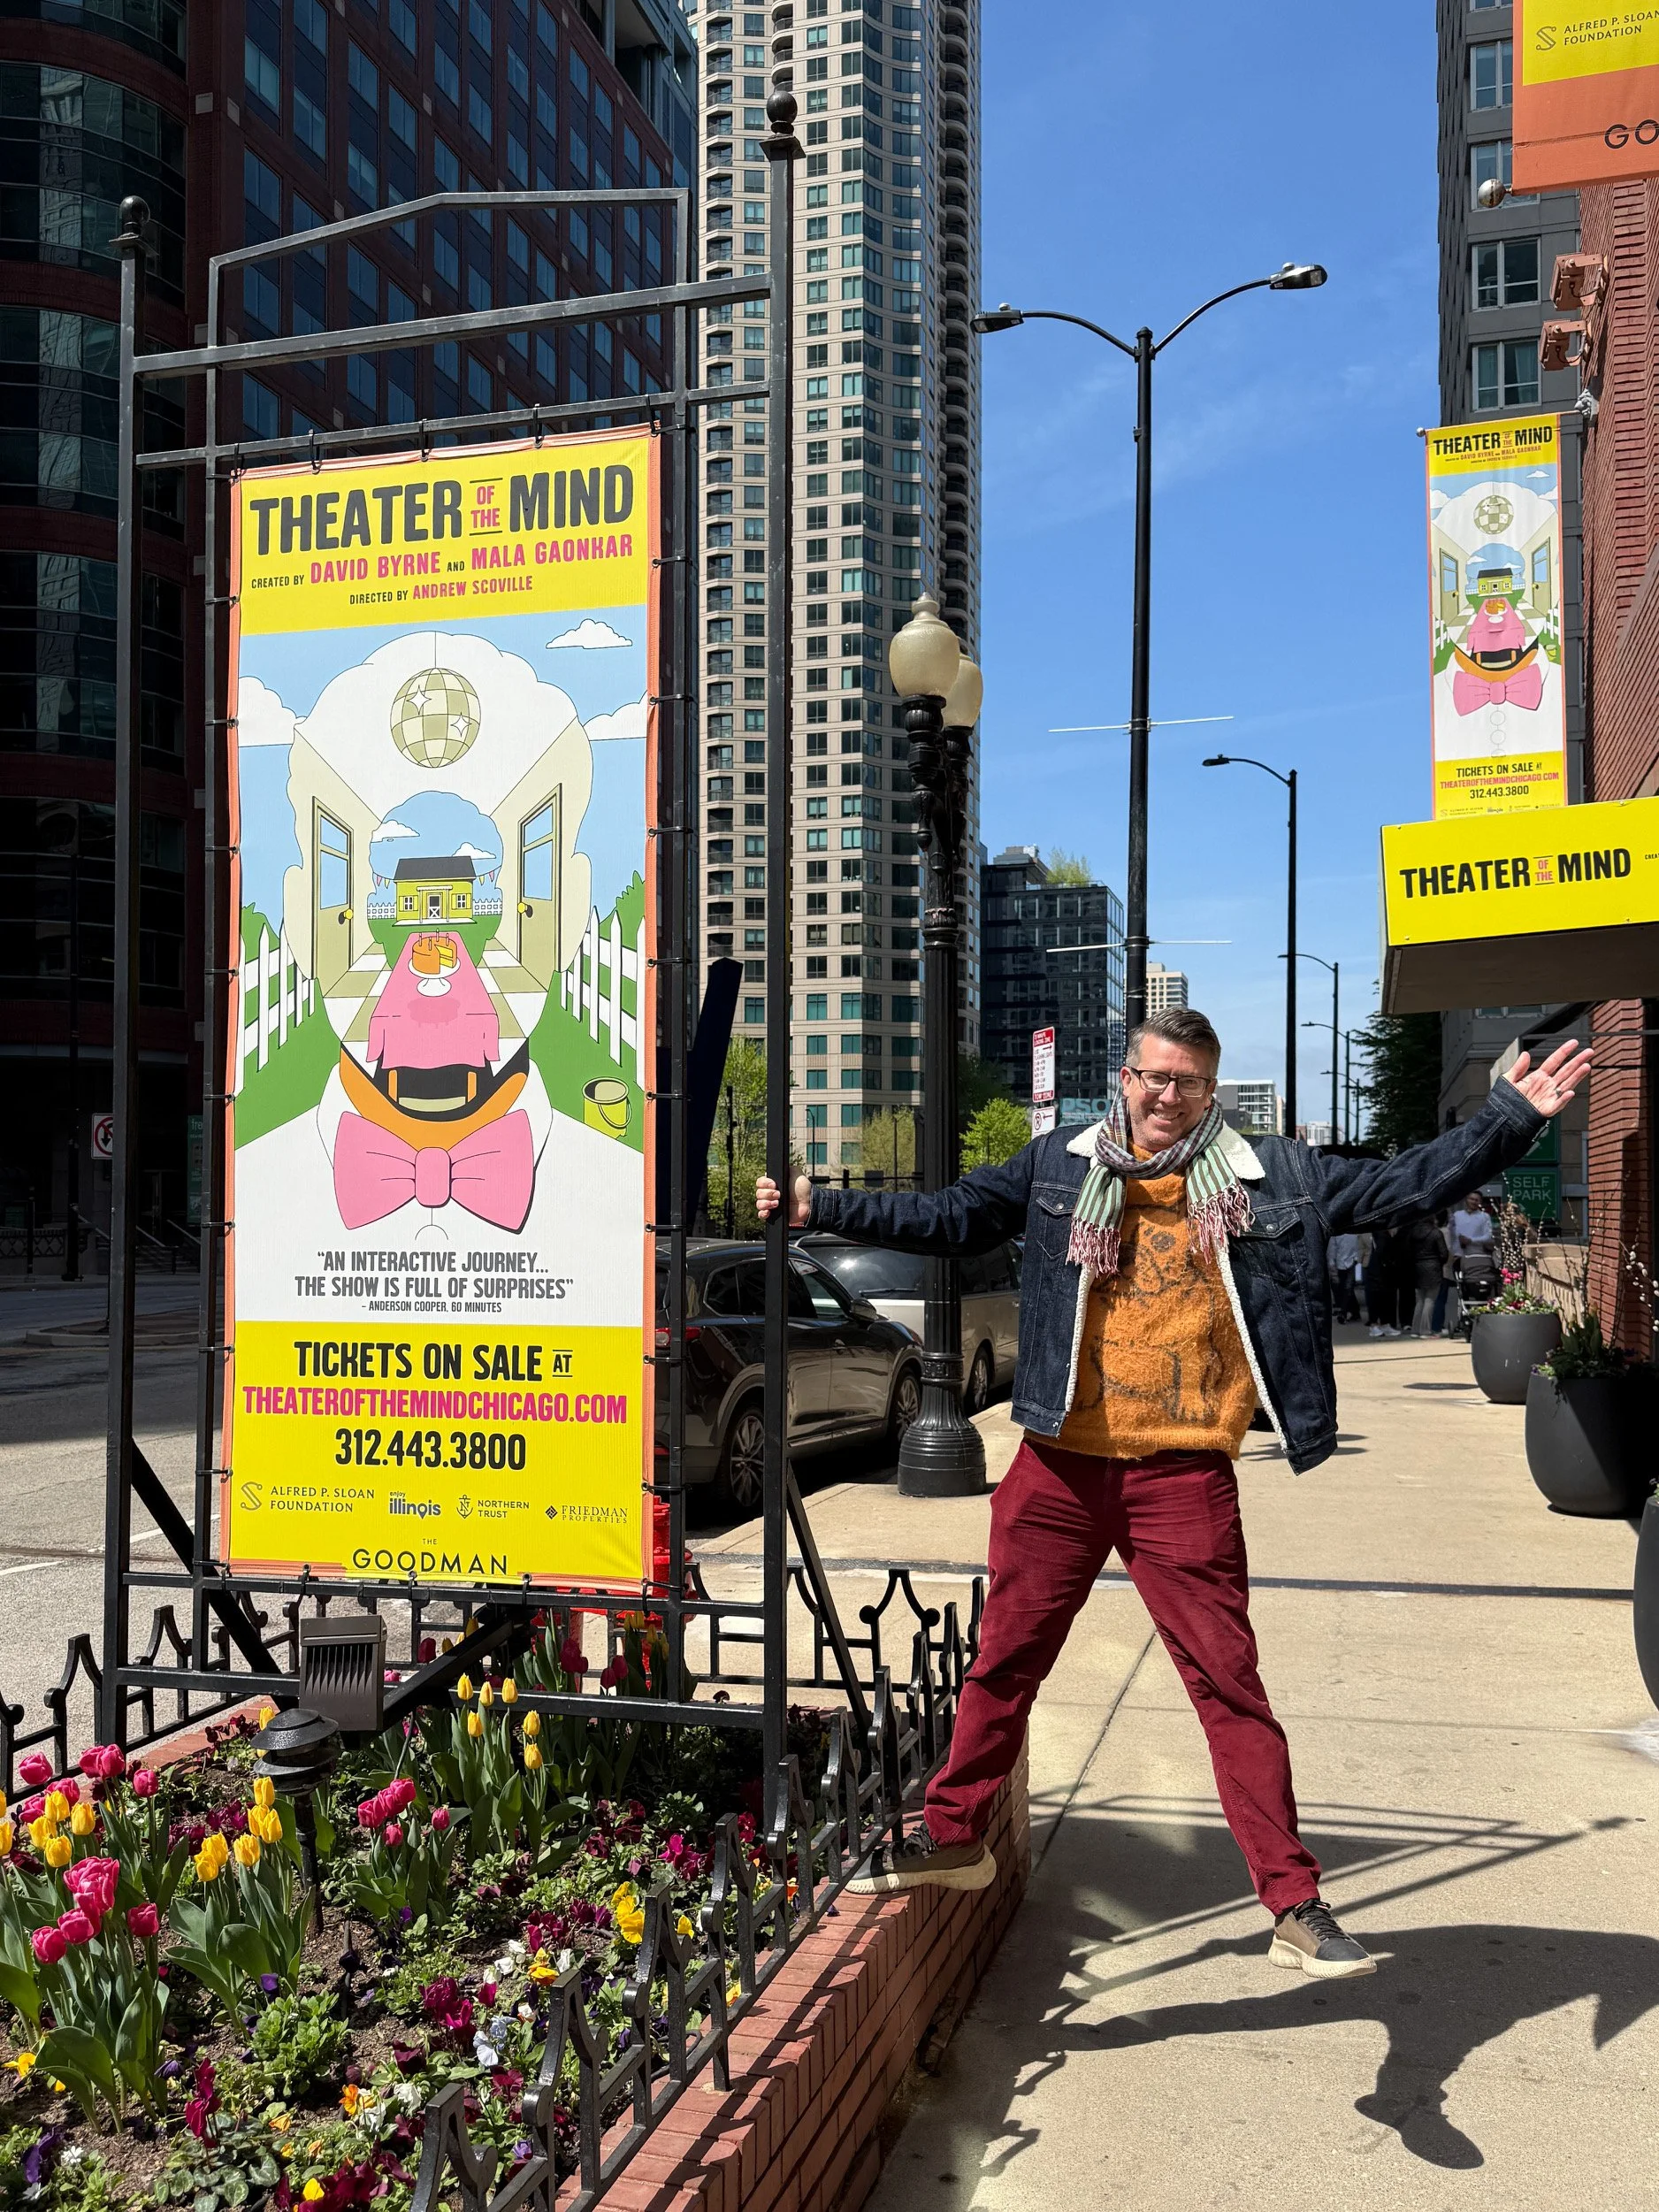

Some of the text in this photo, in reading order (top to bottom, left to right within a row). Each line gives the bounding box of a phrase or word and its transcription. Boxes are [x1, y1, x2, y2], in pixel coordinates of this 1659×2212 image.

[1563, 18, 1607, 34] ALFRED
[1611, 16, 1620, 26] P.
[1563, 25, 1642, 45] FOUNDATION
[1433, 432, 1501, 455] THEATER
[1515, 426, 1553, 447] MIND
[250, 464, 633, 555] THEATER OF THE MIND
[251, 534, 633, 589] CREATED BY DAVID BYRNE AND MALA GAONKAR
[349, 576, 532, 605] DIRECTED BY ANDREW SCOVILLE
[1456, 766, 1494, 777] TICKETS
[1496, 764, 1509, 775] ON
[1511, 762, 1533, 773] SALE
[1470, 785, 1529, 800] 312.443.3800
[1400, 848, 1632, 899] THEATER OF THE MIND
[1512, 1176, 1550, 1189] SELF
[1513, 1190, 1552, 1201] PARK
[351, 1251, 458, 1273] INTERACTIVE
[462, 1251, 549, 1274] JOURNEY...
[294, 1276, 573, 1299] THE SHOW IS FULL OF SURPRISES”
[369, 1301, 411, 1312] ANDERSON
[451, 1303, 462, 1313] 60
[464, 1303, 501, 1313] MINUTES
[294, 1341, 572, 1382] TICKETS ON SALE AT
[242, 1386, 627, 1424] THEATEROFTHEMINDCHICAGO.COM
[335, 1428, 526, 1470] 312.443.3800
[271, 1486, 375, 1499] ALFRED P. SLOAN
[270, 1500, 353, 1512] FOUNDATION
[389, 1498, 441, 1519] illinois
[478, 1499, 530, 1509] NORTHERN
[562, 1504, 628, 1517] FRIEDMAN
[478, 1510, 508, 1519] TRUST
[562, 1514, 628, 1524] PROPERTIES
[352, 1548, 507, 1575] GOODMAN
